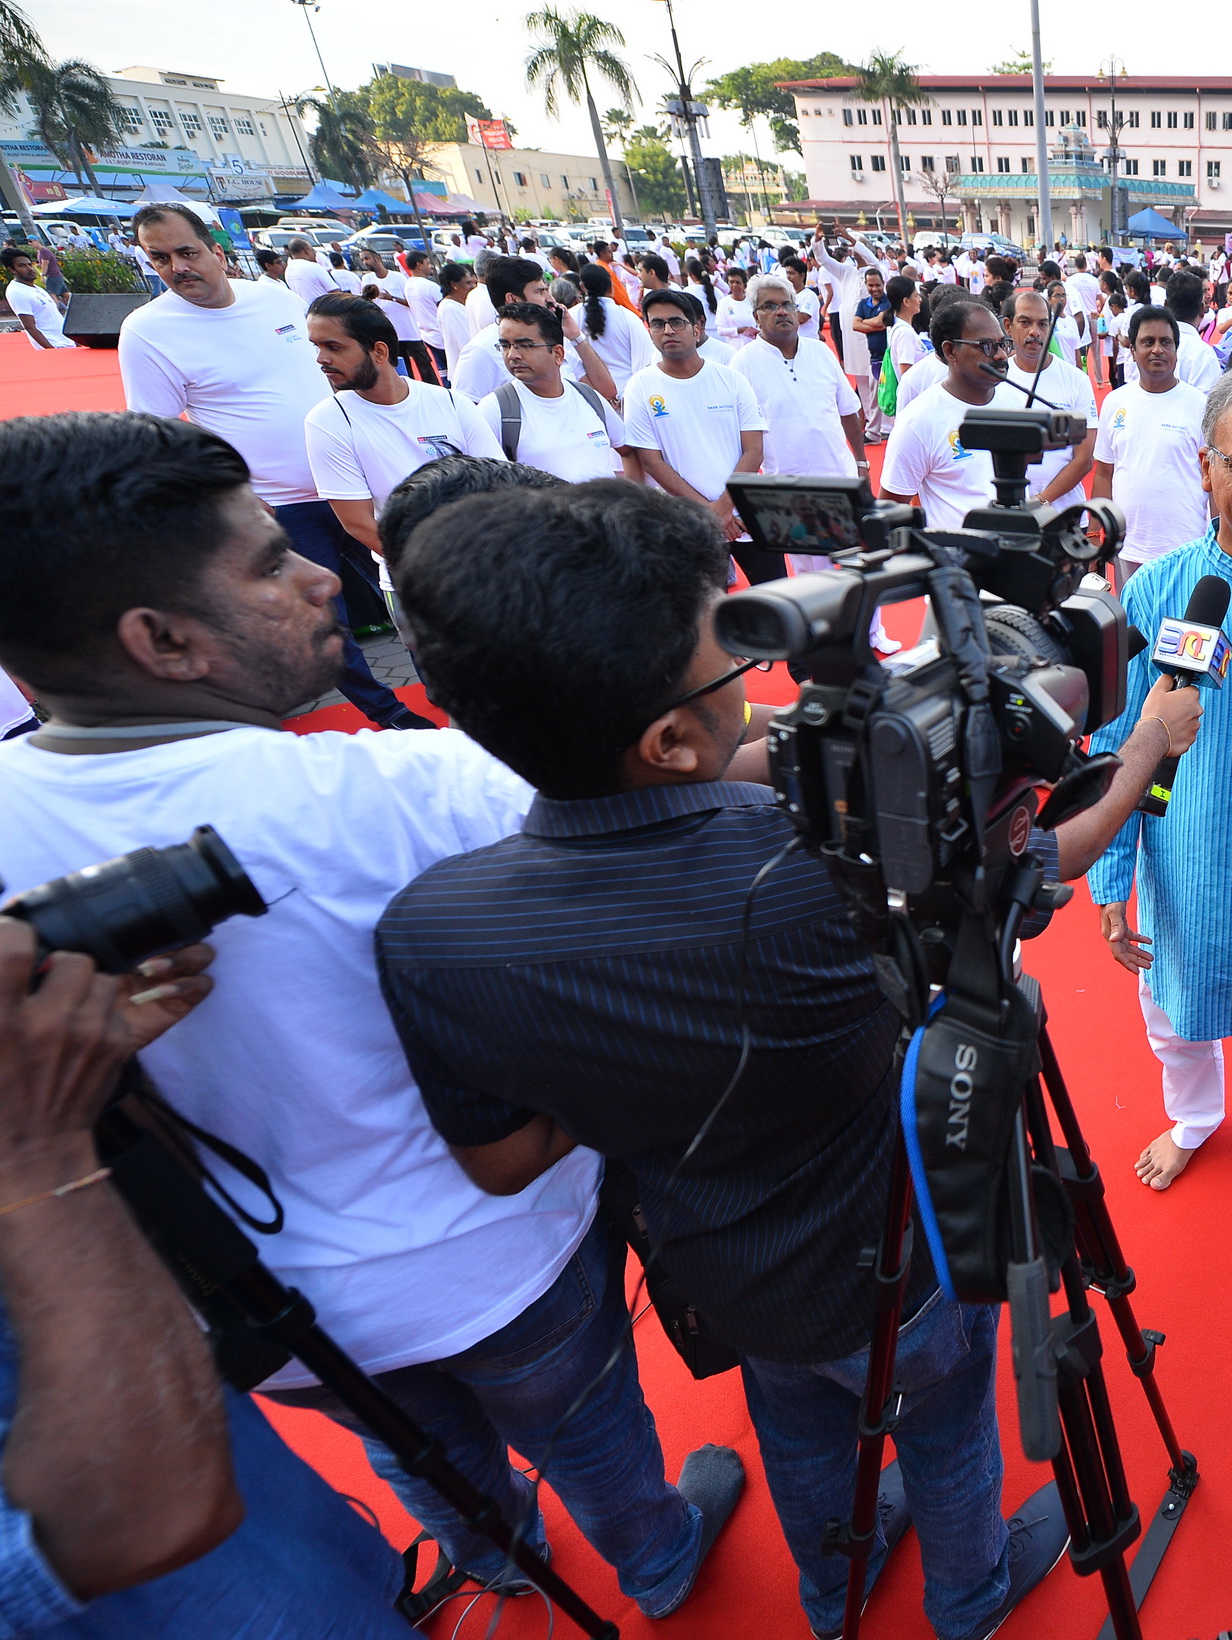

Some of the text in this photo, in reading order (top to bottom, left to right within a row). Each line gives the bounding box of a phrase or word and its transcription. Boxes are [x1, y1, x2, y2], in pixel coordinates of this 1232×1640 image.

[131, 153, 167, 162] RESTORAN
[232, 160, 244, 175] 5
[945, 1043, 978, 1151] SONY
